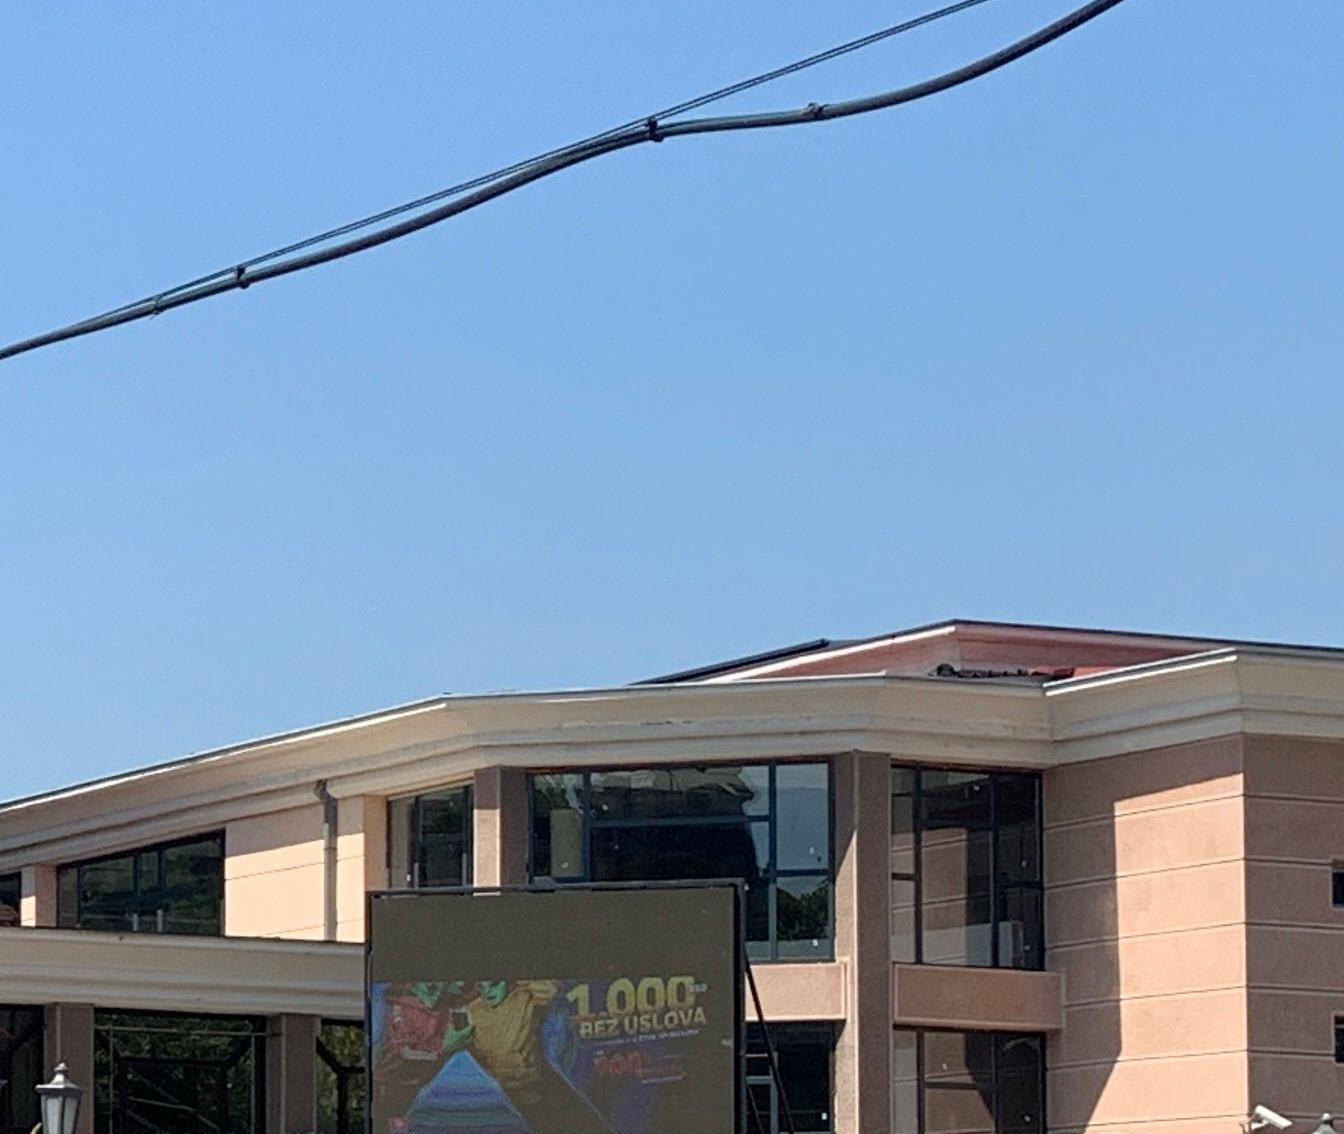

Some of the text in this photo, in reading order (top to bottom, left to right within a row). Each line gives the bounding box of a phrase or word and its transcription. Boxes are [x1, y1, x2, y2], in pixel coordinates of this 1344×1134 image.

[566, 975, 696, 1017] 1.000
[579, 1018, 618, 1039] BEZ
[624, 1006, 708, 1034] USLOVA
